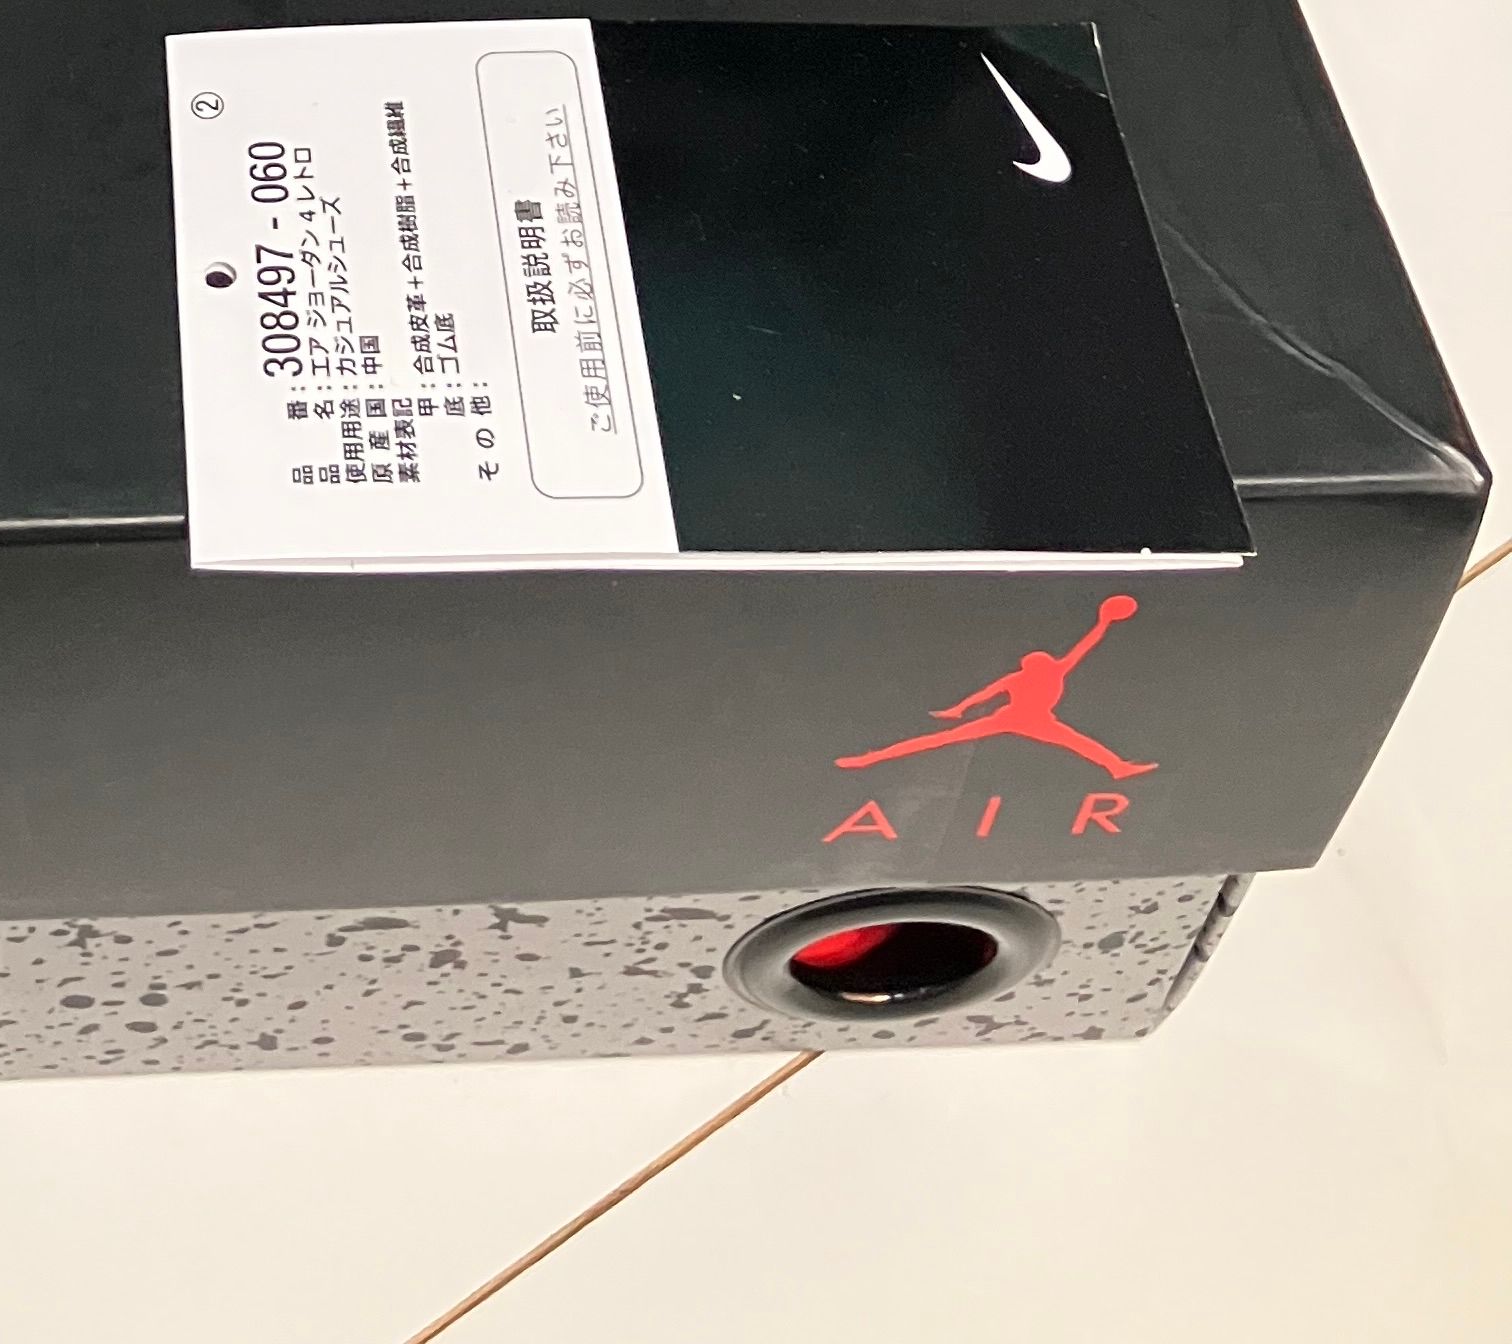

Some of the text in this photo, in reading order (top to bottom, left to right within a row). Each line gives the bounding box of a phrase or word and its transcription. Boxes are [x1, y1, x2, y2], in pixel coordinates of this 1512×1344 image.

[514, 200, 560, 334] 取扱説明書
[545, 108, 613, 433] ご使用前に必ずお読み下さい
[391, 398, 421, 483] 素材表記
[820, 792, 1130, 843] AIR
